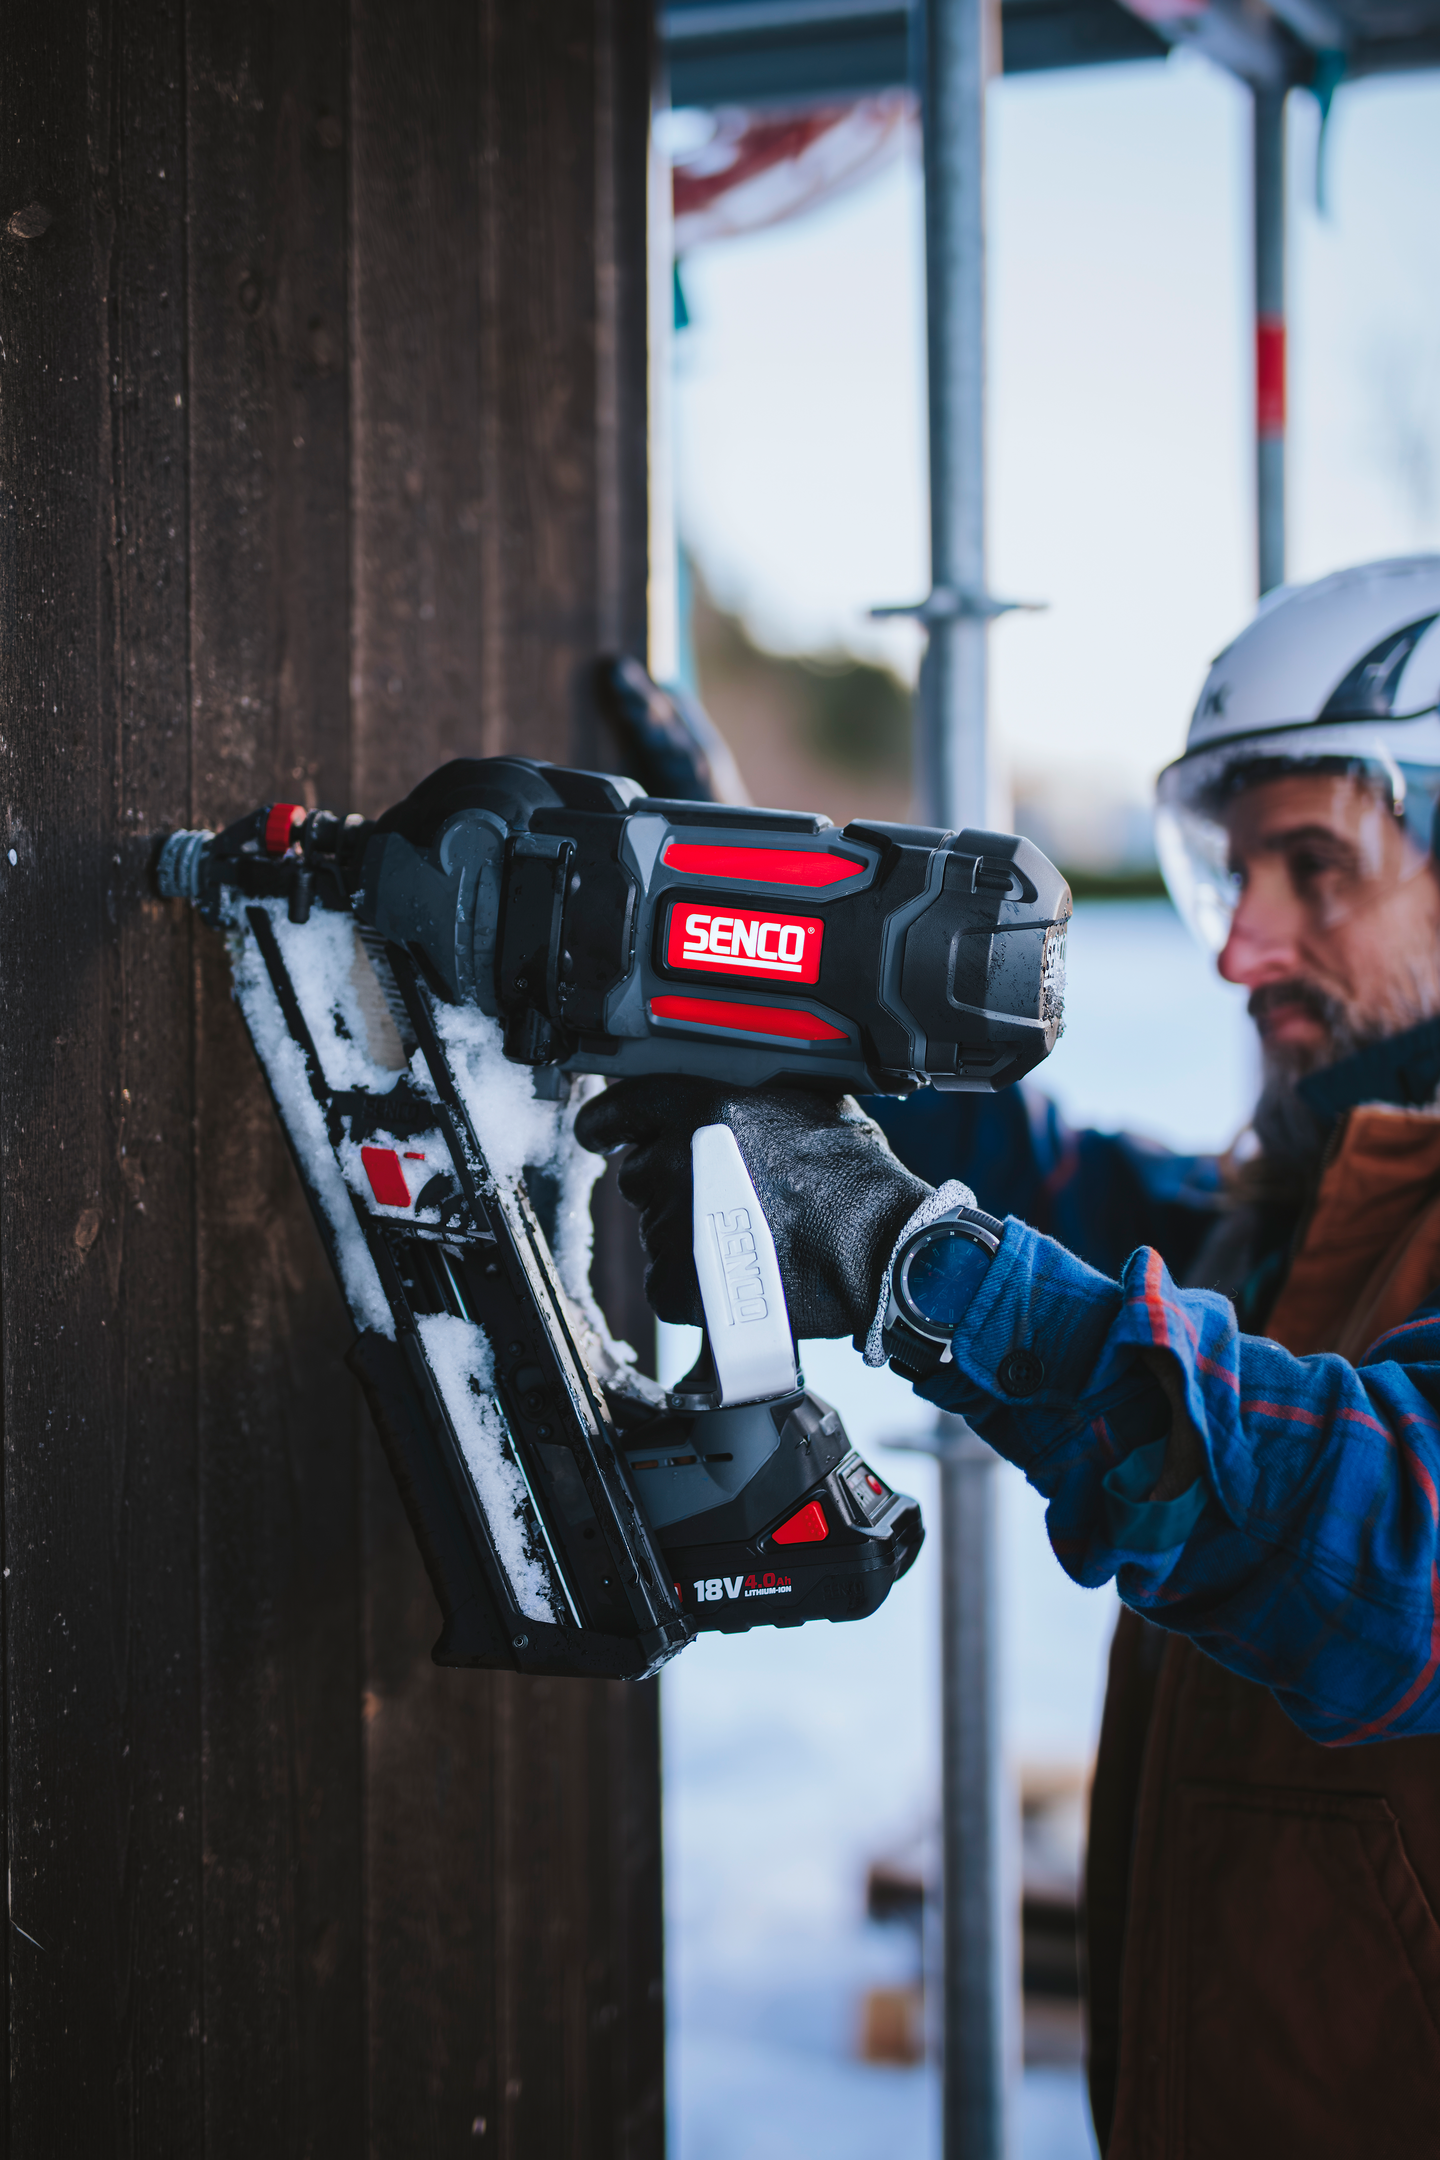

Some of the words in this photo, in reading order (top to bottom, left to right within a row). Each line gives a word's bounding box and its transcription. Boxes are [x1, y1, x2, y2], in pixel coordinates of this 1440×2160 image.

[683, 913, 806, 963] SENCO
[714, 1207, 769, 1324] SENCO
[693, 1576, 745, 1602] 18V
[745, 1572, 792, 1589] 4.0Ah
[745, 1585, 793, 1598] LITHIUM-ION
